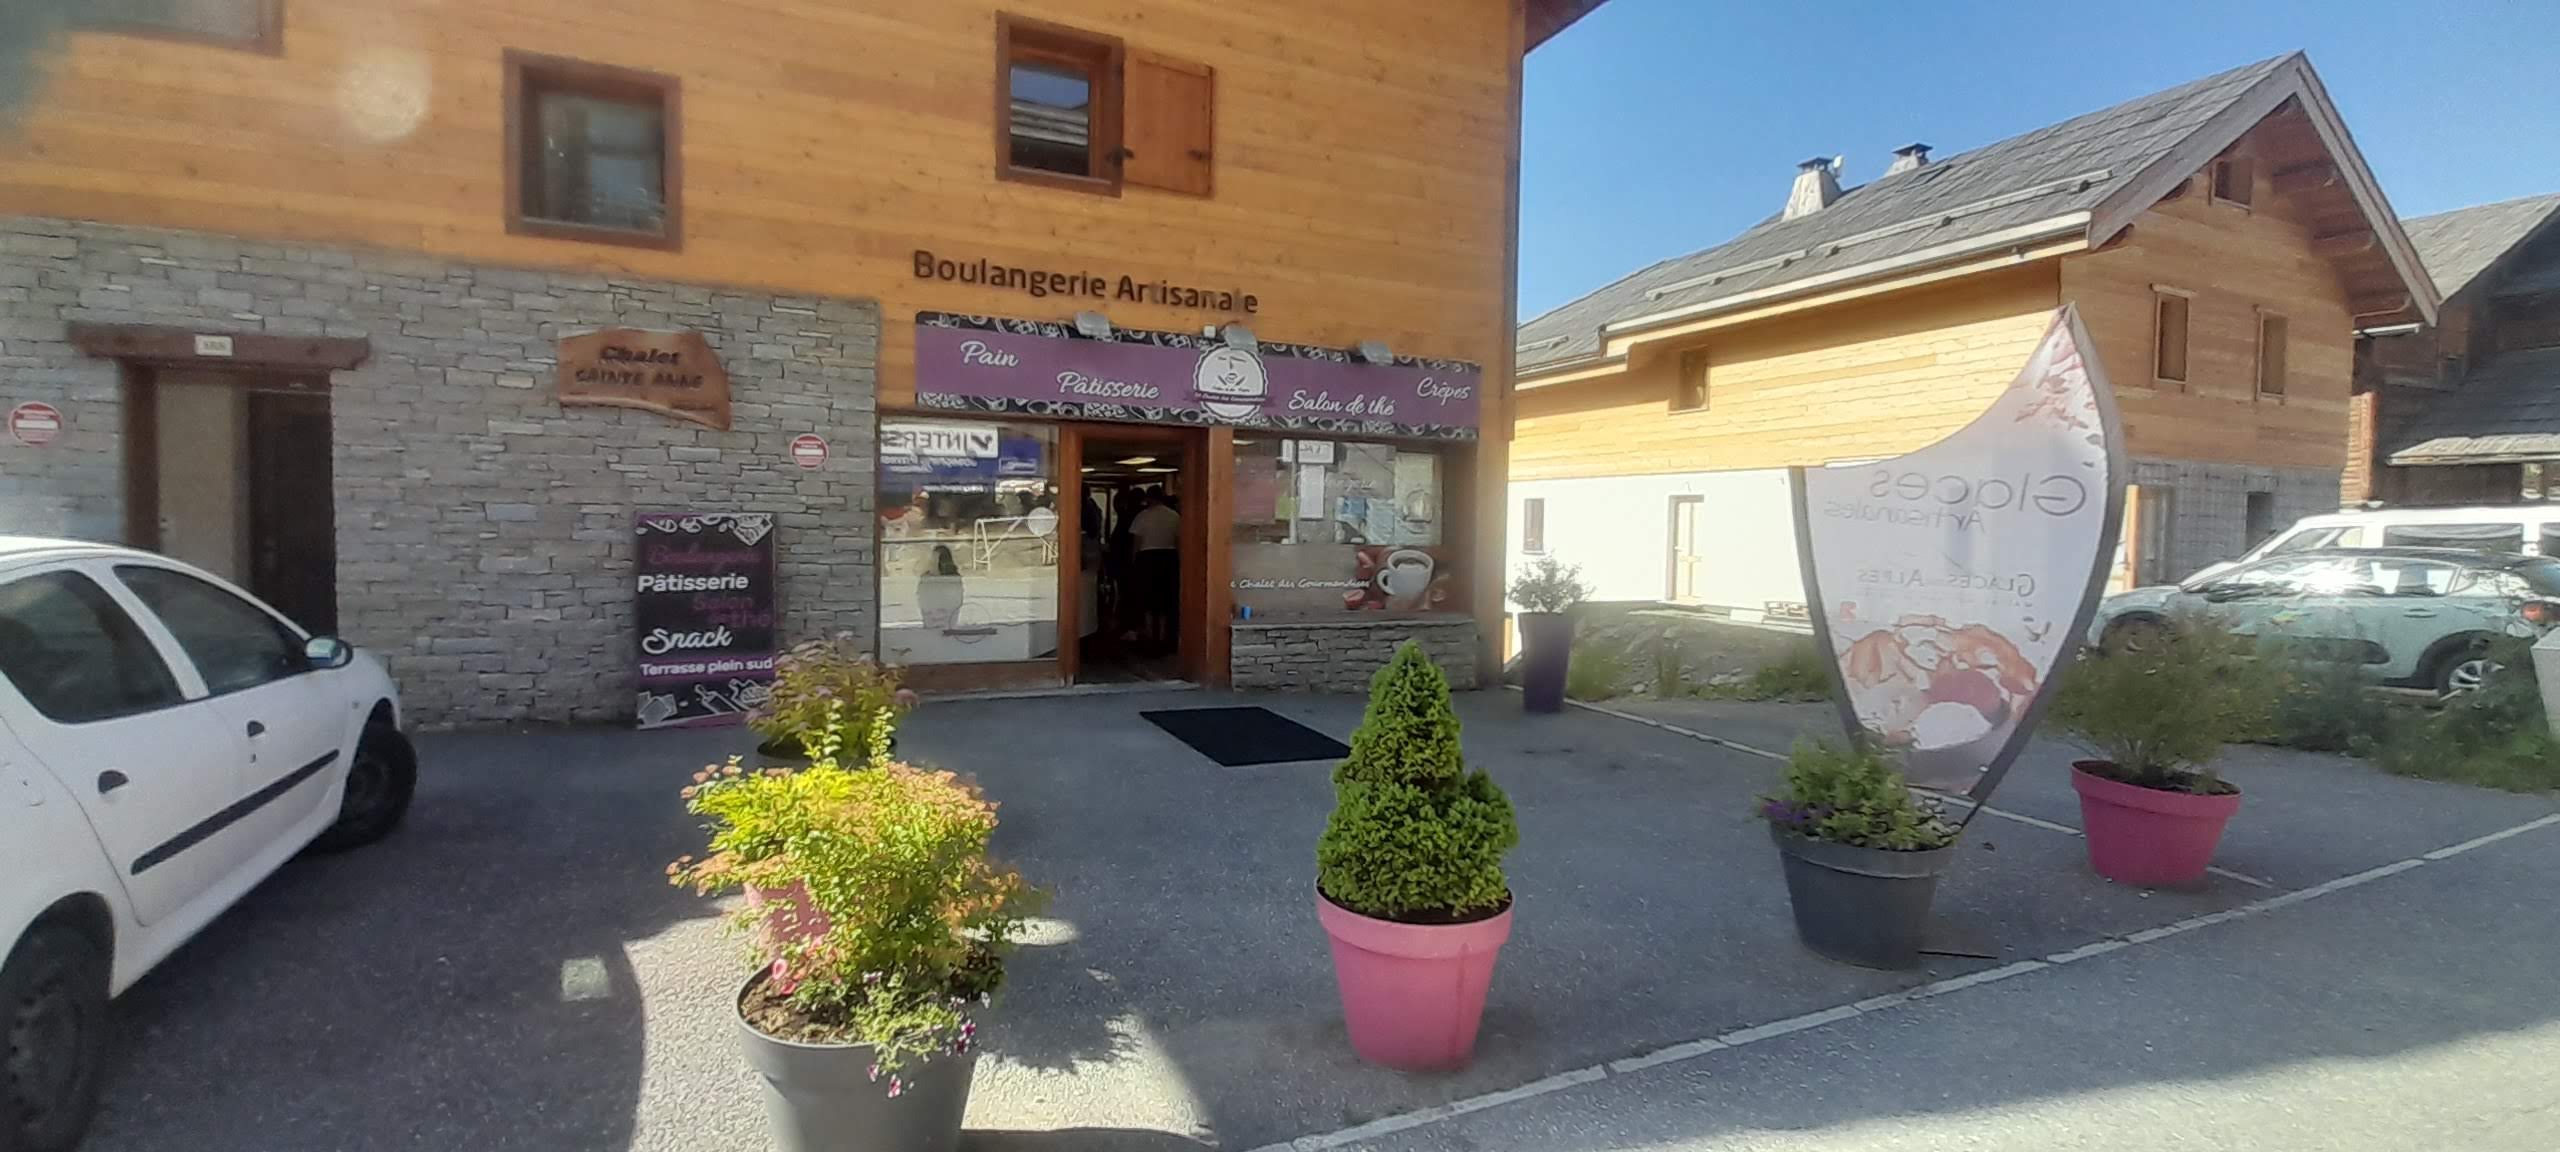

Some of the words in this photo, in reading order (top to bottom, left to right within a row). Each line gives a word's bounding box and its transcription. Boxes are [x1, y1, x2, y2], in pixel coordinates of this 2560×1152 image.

[913, 250, 1106, 298] Boulangerie
[1117, 275, 1259, 313] Artisanale
[600, 346, 680, 365] Chalet
[960, 340, 1019, 367] Pain
[1057, 371, 1160, 399] Pâtisserie
[1416, 376, 1472, 406] Crêpes
[1288, 389, 1342, 413] Salon
[1345, 394, 1365, 416] de
[1368, 395, 1395, 416] thé
[637, 573, 749, 593] Pâtisserie
[642, 626, 733, 654] Snack
[640, 662, 704, 677] Terrasse
[707, 659, 744, 675] plein
[747, 657, 773, 671] sud
